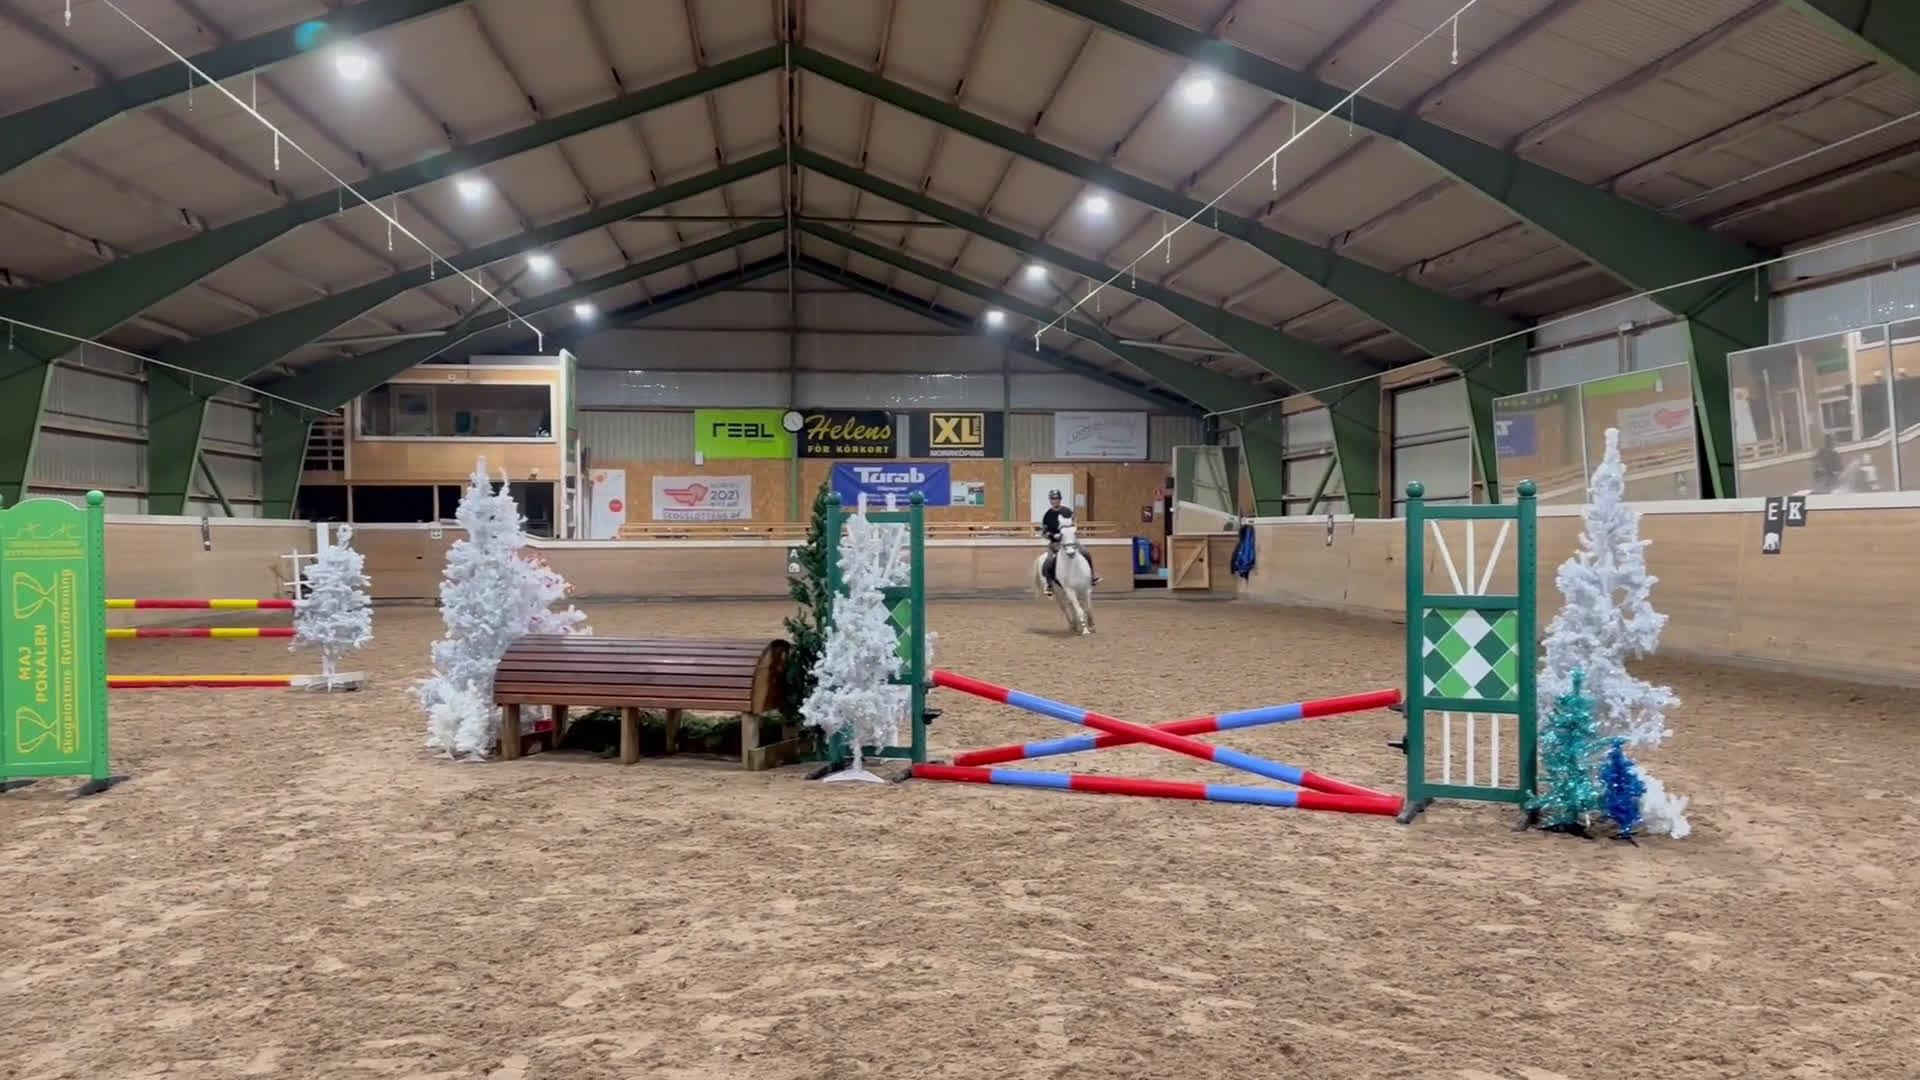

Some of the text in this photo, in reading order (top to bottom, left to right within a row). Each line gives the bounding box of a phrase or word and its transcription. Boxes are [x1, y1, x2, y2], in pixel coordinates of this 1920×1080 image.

[804, 414, 891, 440] Helens
[934, 417, 981, 443] XL
[836, 444, 889, 453] KÖRKORT
[711, 490, 739, 500] 2021
[1768, 503, 1779, 520] E
[1788, 502, 1802, 519] K
[790, 549, 799, 558] A
[18, 647, 32, 680] MAJ
[35, 625, 47, 702] POKALEN
